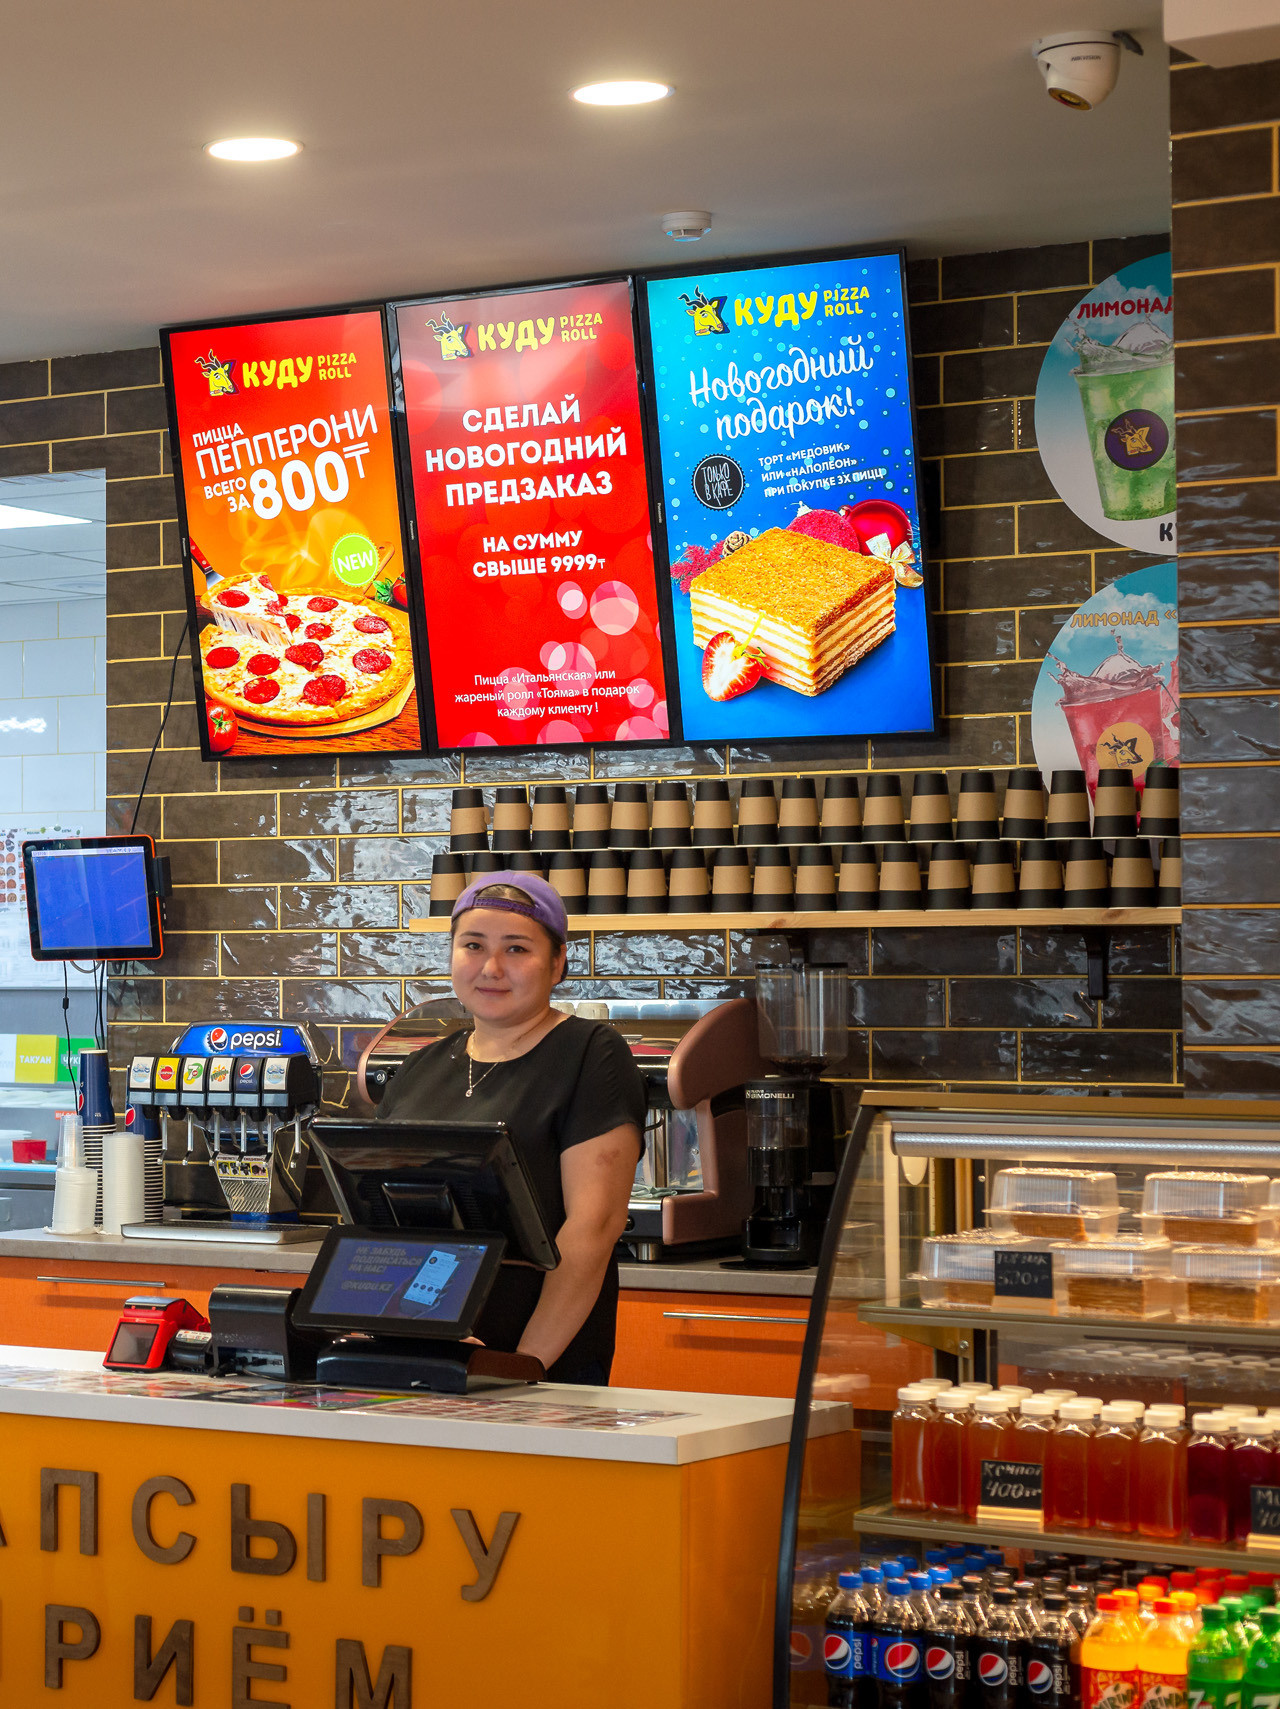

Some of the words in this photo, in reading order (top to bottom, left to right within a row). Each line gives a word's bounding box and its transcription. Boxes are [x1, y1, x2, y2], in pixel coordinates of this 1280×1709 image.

[734, 291, 818, 328] КУДУ
[823, 286, 870, 303] PIZZA
[824, 301, 863, 317] ROLL
[477, 316, 555, 353] КУДУ
[560, 312, 603, 328] PIZZA
[561, 327, 597, 343] ROLL
[242, 355, 313, 390] КУДУ
[317, 352, 357, 367] PIZZA
[318, 366, 352, 381] ROLL
[689, 334, 874, 407] Новогодний
[462, 393, 581, 434] СДЕЛАЙ
[716, 386, 856, 441] подарок!
[192, 422, 244, 448] ПИЦЦА
[195, 403, 378, 480] ПЕППЕРОНИ
[425, 426, 628, 473] НОВОГОДНИЙ
[758, 453, 784, 467] ТОРТ
[785, 442, 850, 461] «МЕДОВИК»
[761, 470, 783, 482] ИЛИ
[785, 457, 857, 479] «НАПОЛЕОН»
[204, 477, 247, 500] ВСЕГО
[445, 470, 613, 507] ПРЕДЗАКАЗ
[764, 486, 785, 498] ПРИ
[786, 478, 836, 496] ПОКУПКЕ
[852, 467, 884, 482] ПИЦЦ
[227, 497, 251, 513] ЗА
[483, 536, 510, 554] НА
[513, 530, 583, 551] СУММУ
[337, 550, 374, 573] NEW
[472, 557, 547, 578] СВЫШЕ
[1071, 610, 1159, 628] ЛИМОНАД
[474, 674, 509, 687] Пицца
[511, 670, 592, 685] «Итальянская»
[595, 670, 616, 680] или
[455, 689, 505, 705] жареный
[507, 690, 534, 704] ролл
[536, 688, 580, 700] «Тояма»
[582, 689, 589, 697] в
[591, 685, 640, 700] подарок
[497, 705, 545, 719] каждому
[548, 703, 593, 717] клиенту
[20, 1055, 51, 1064] ТАКУАН
[853, 1638, 863, 1670] pepsi
[955, 1650, 966, 1680] pepsi
[1008, 1656, 1018, 1686] pepsi
[1052, 1665, 1064, 1695] pepsi
